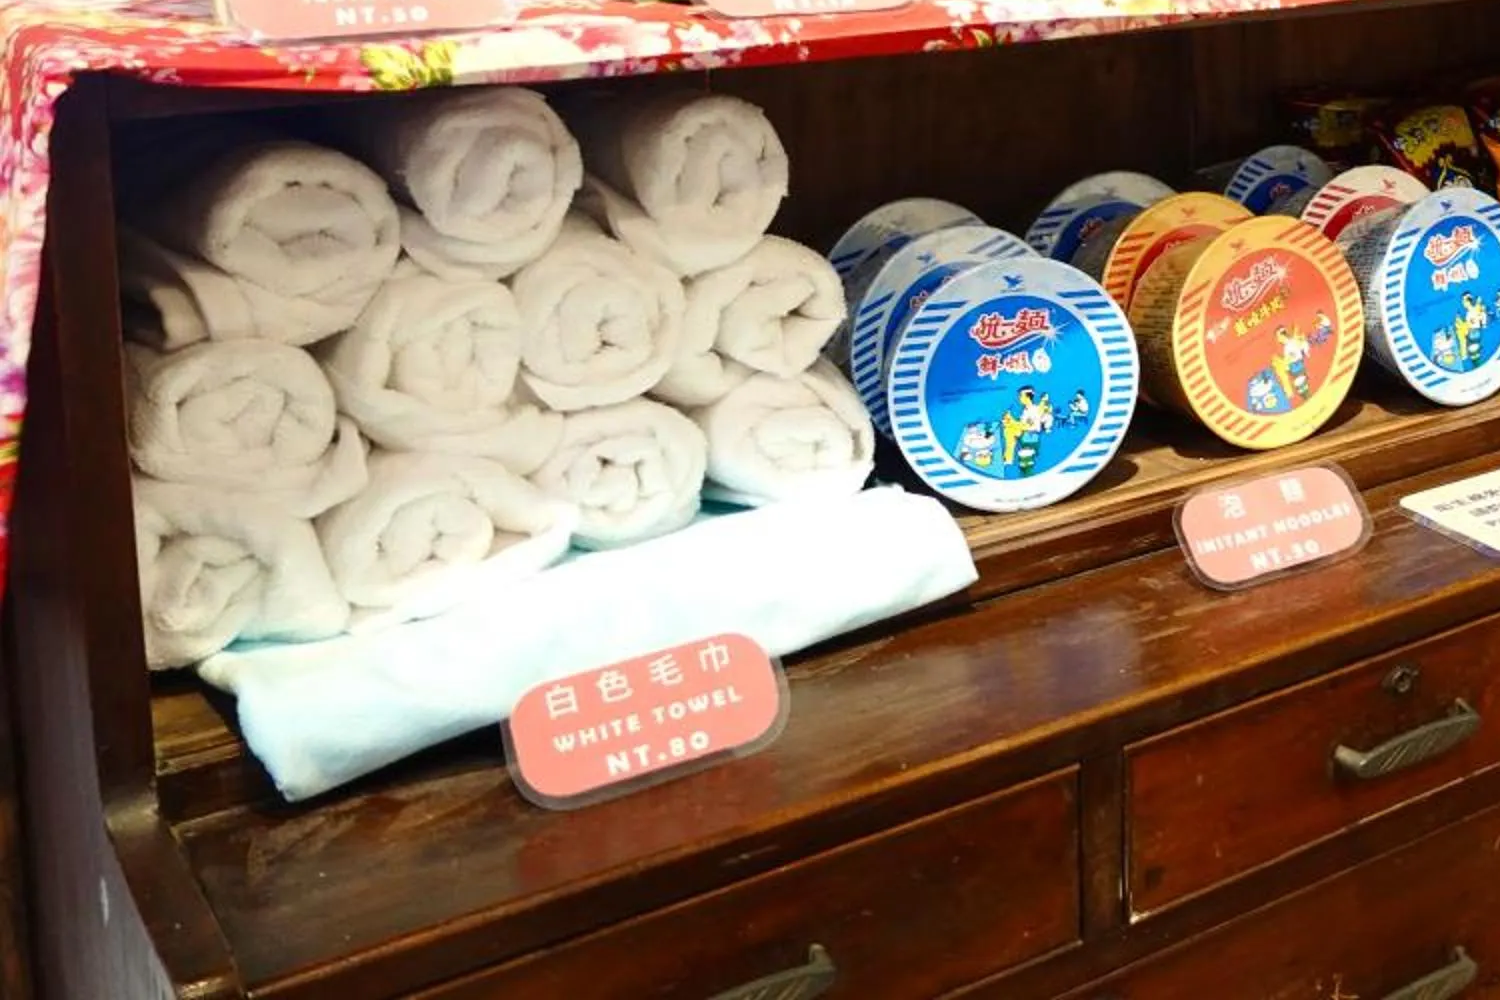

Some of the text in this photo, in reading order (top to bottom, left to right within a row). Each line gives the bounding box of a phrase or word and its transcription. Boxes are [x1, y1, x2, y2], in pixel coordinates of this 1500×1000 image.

[1196, 501, 1350, 554] INSTANT NOODLES
[544, 641, 731, 719] 白色毛巾
[553, 686, 743, 754] WHITE TOWEL
[606, 730, 710, 777] NT.80
